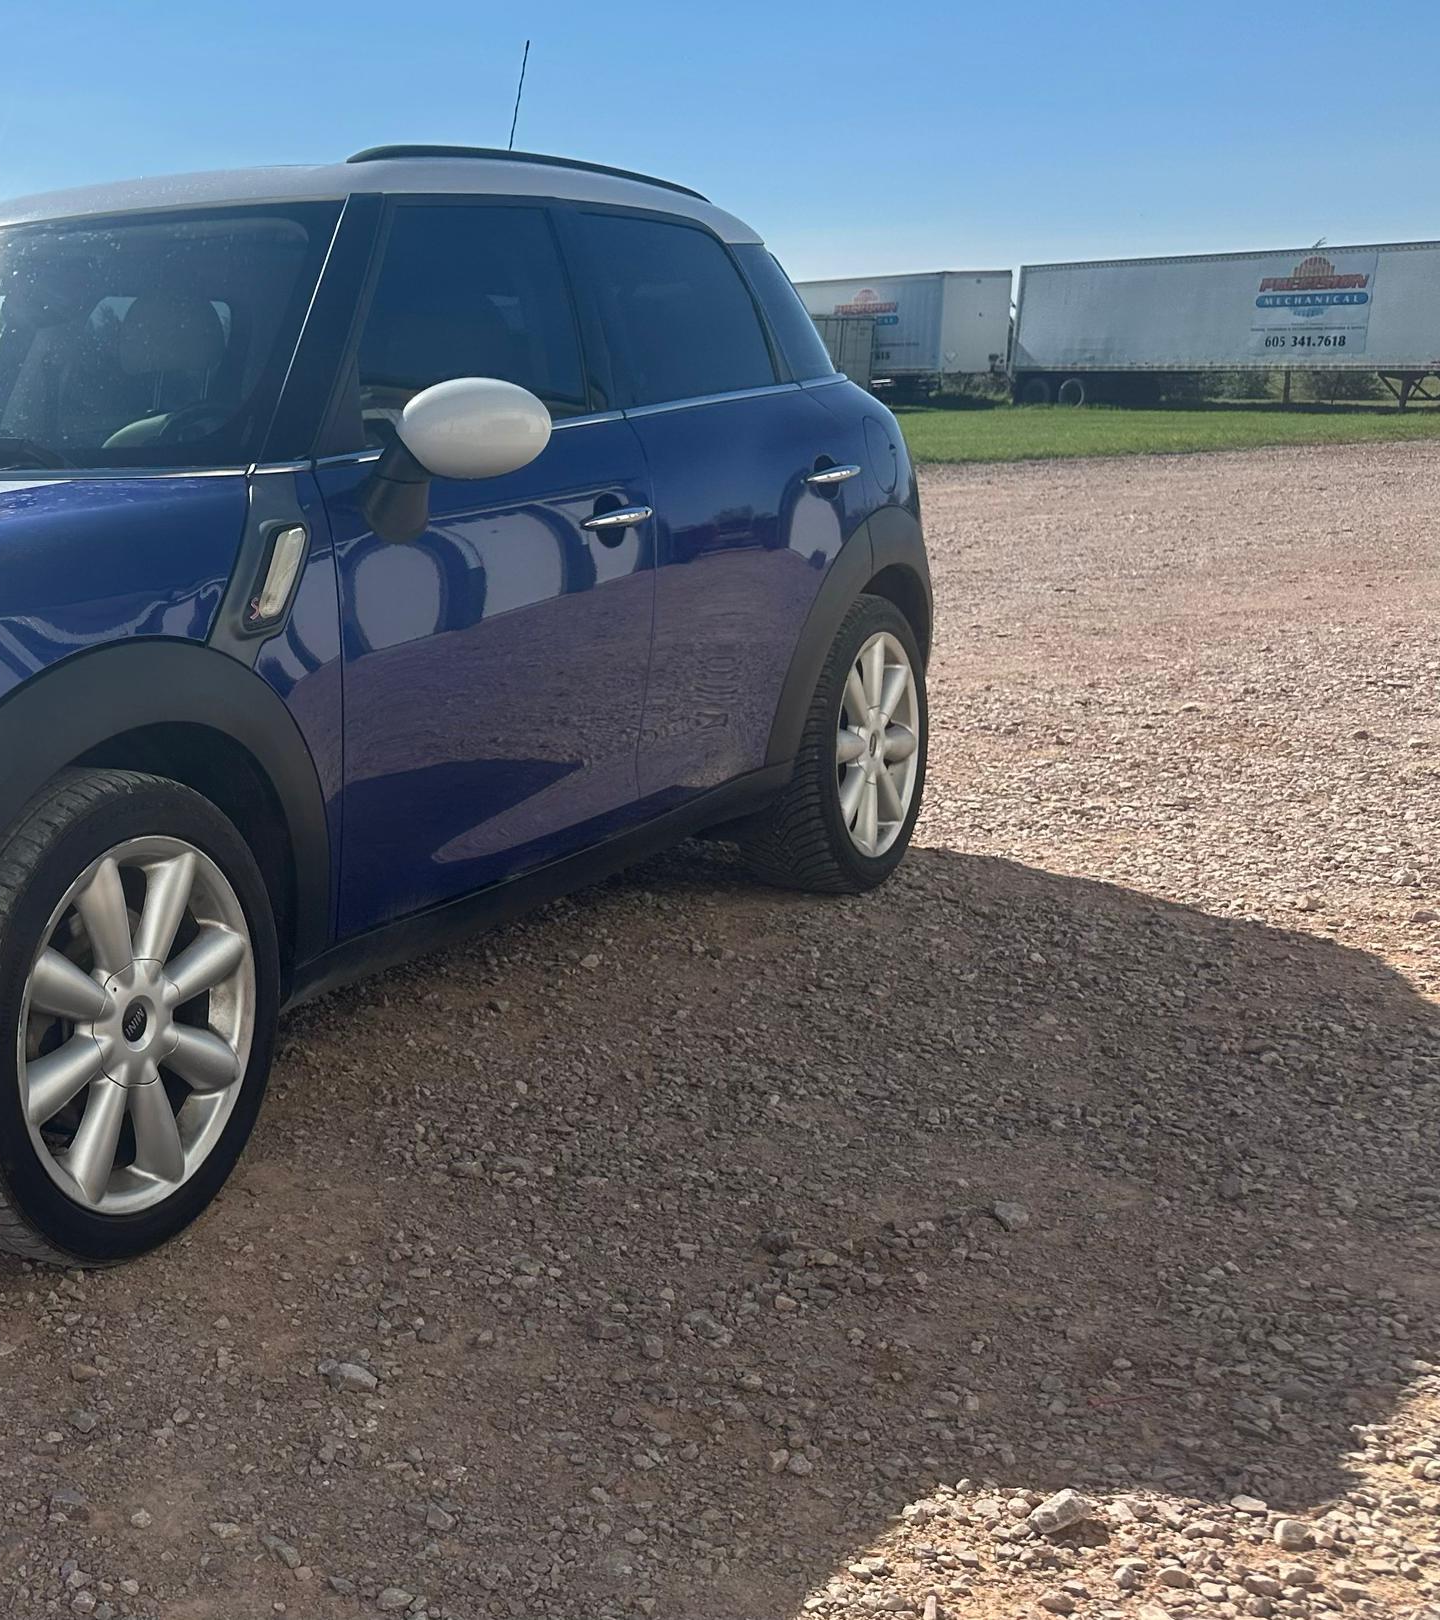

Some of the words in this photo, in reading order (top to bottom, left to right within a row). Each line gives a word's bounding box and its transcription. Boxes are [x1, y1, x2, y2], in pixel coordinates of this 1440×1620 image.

[1259, 273, 1369, 292] PRECISION
[1264, 293, 1360, 306] MECHANICAL
[1265, 335, 1286, 347] 605
[1291, 335, 1347, 347] 341.7618
[125, 1008, 145, 1037] MINI
